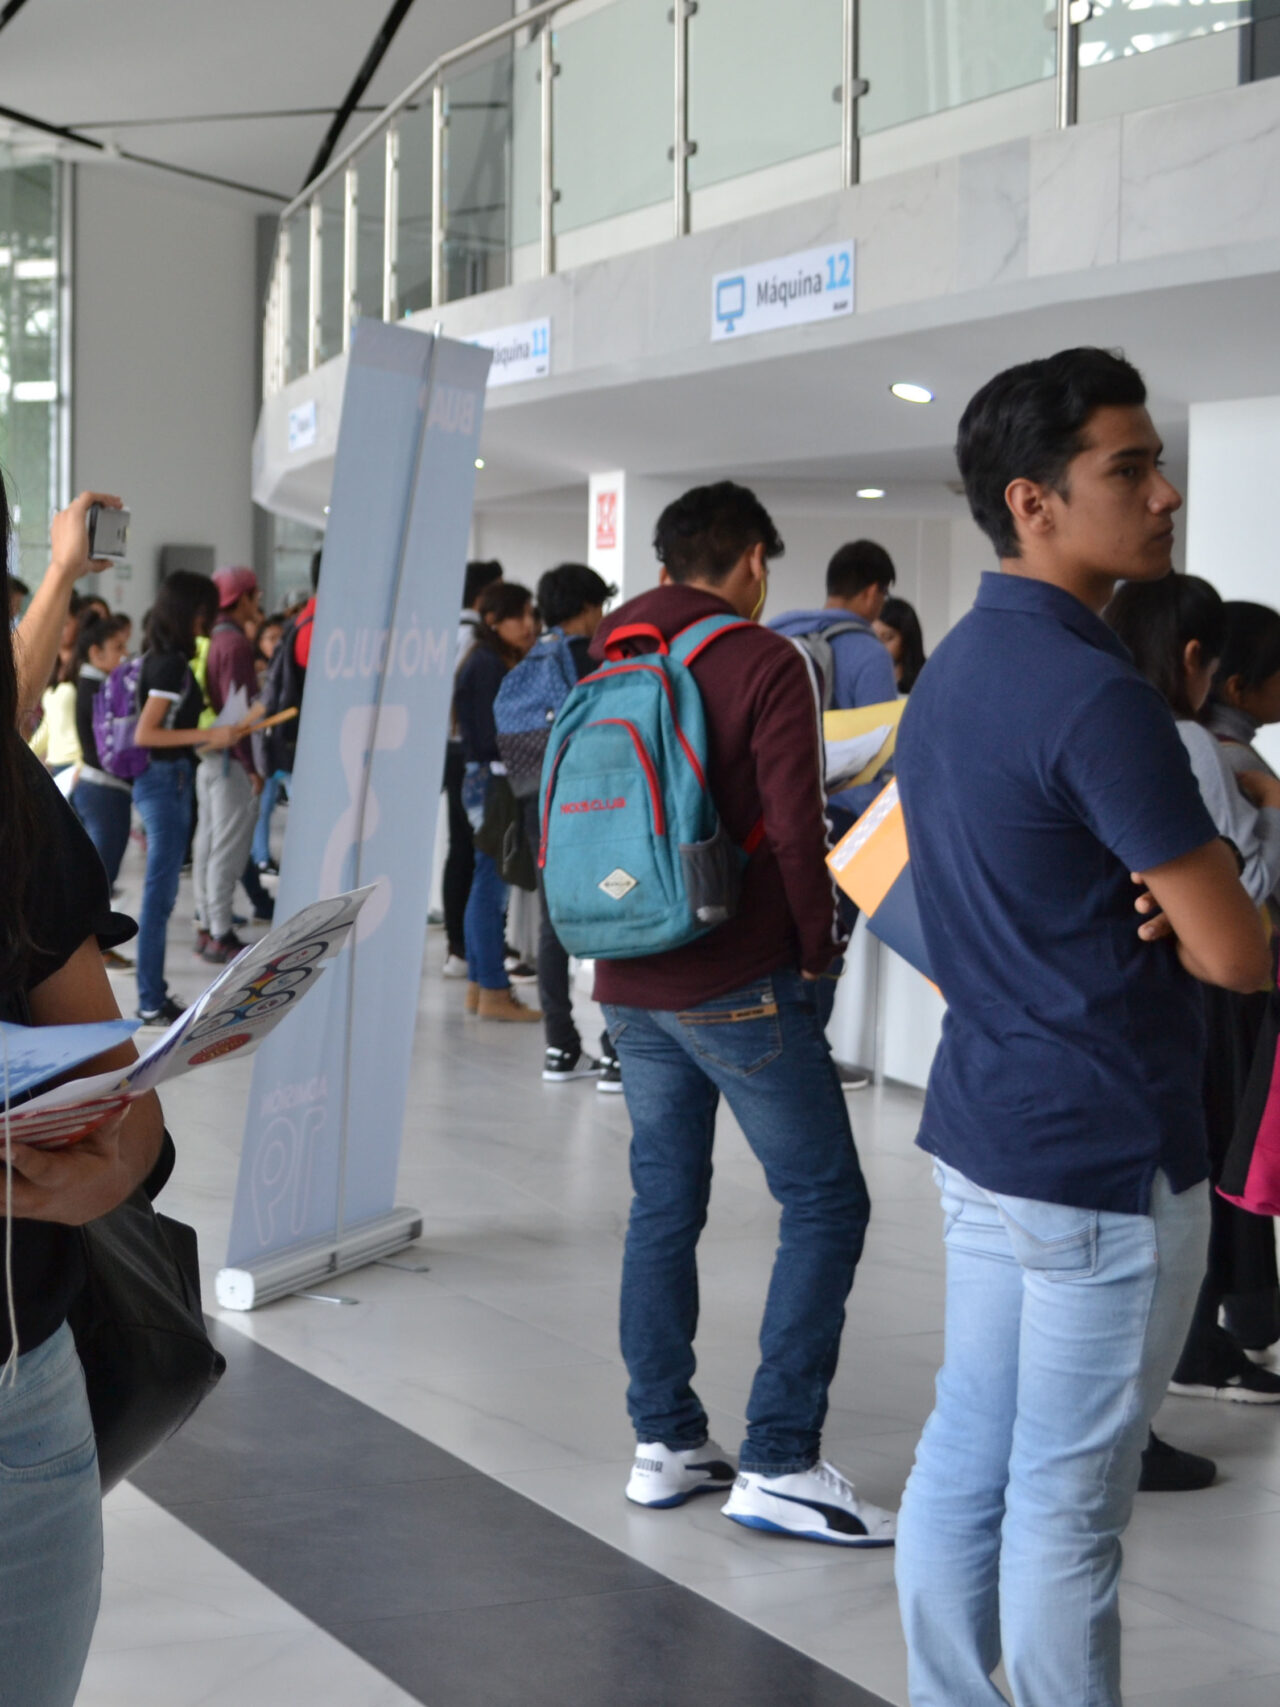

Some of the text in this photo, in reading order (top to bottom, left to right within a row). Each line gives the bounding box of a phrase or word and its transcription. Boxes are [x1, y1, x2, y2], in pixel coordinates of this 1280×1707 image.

[756, 252, 851, 308] Máquina 12
[493, 327, 548, 368] áquina 11
